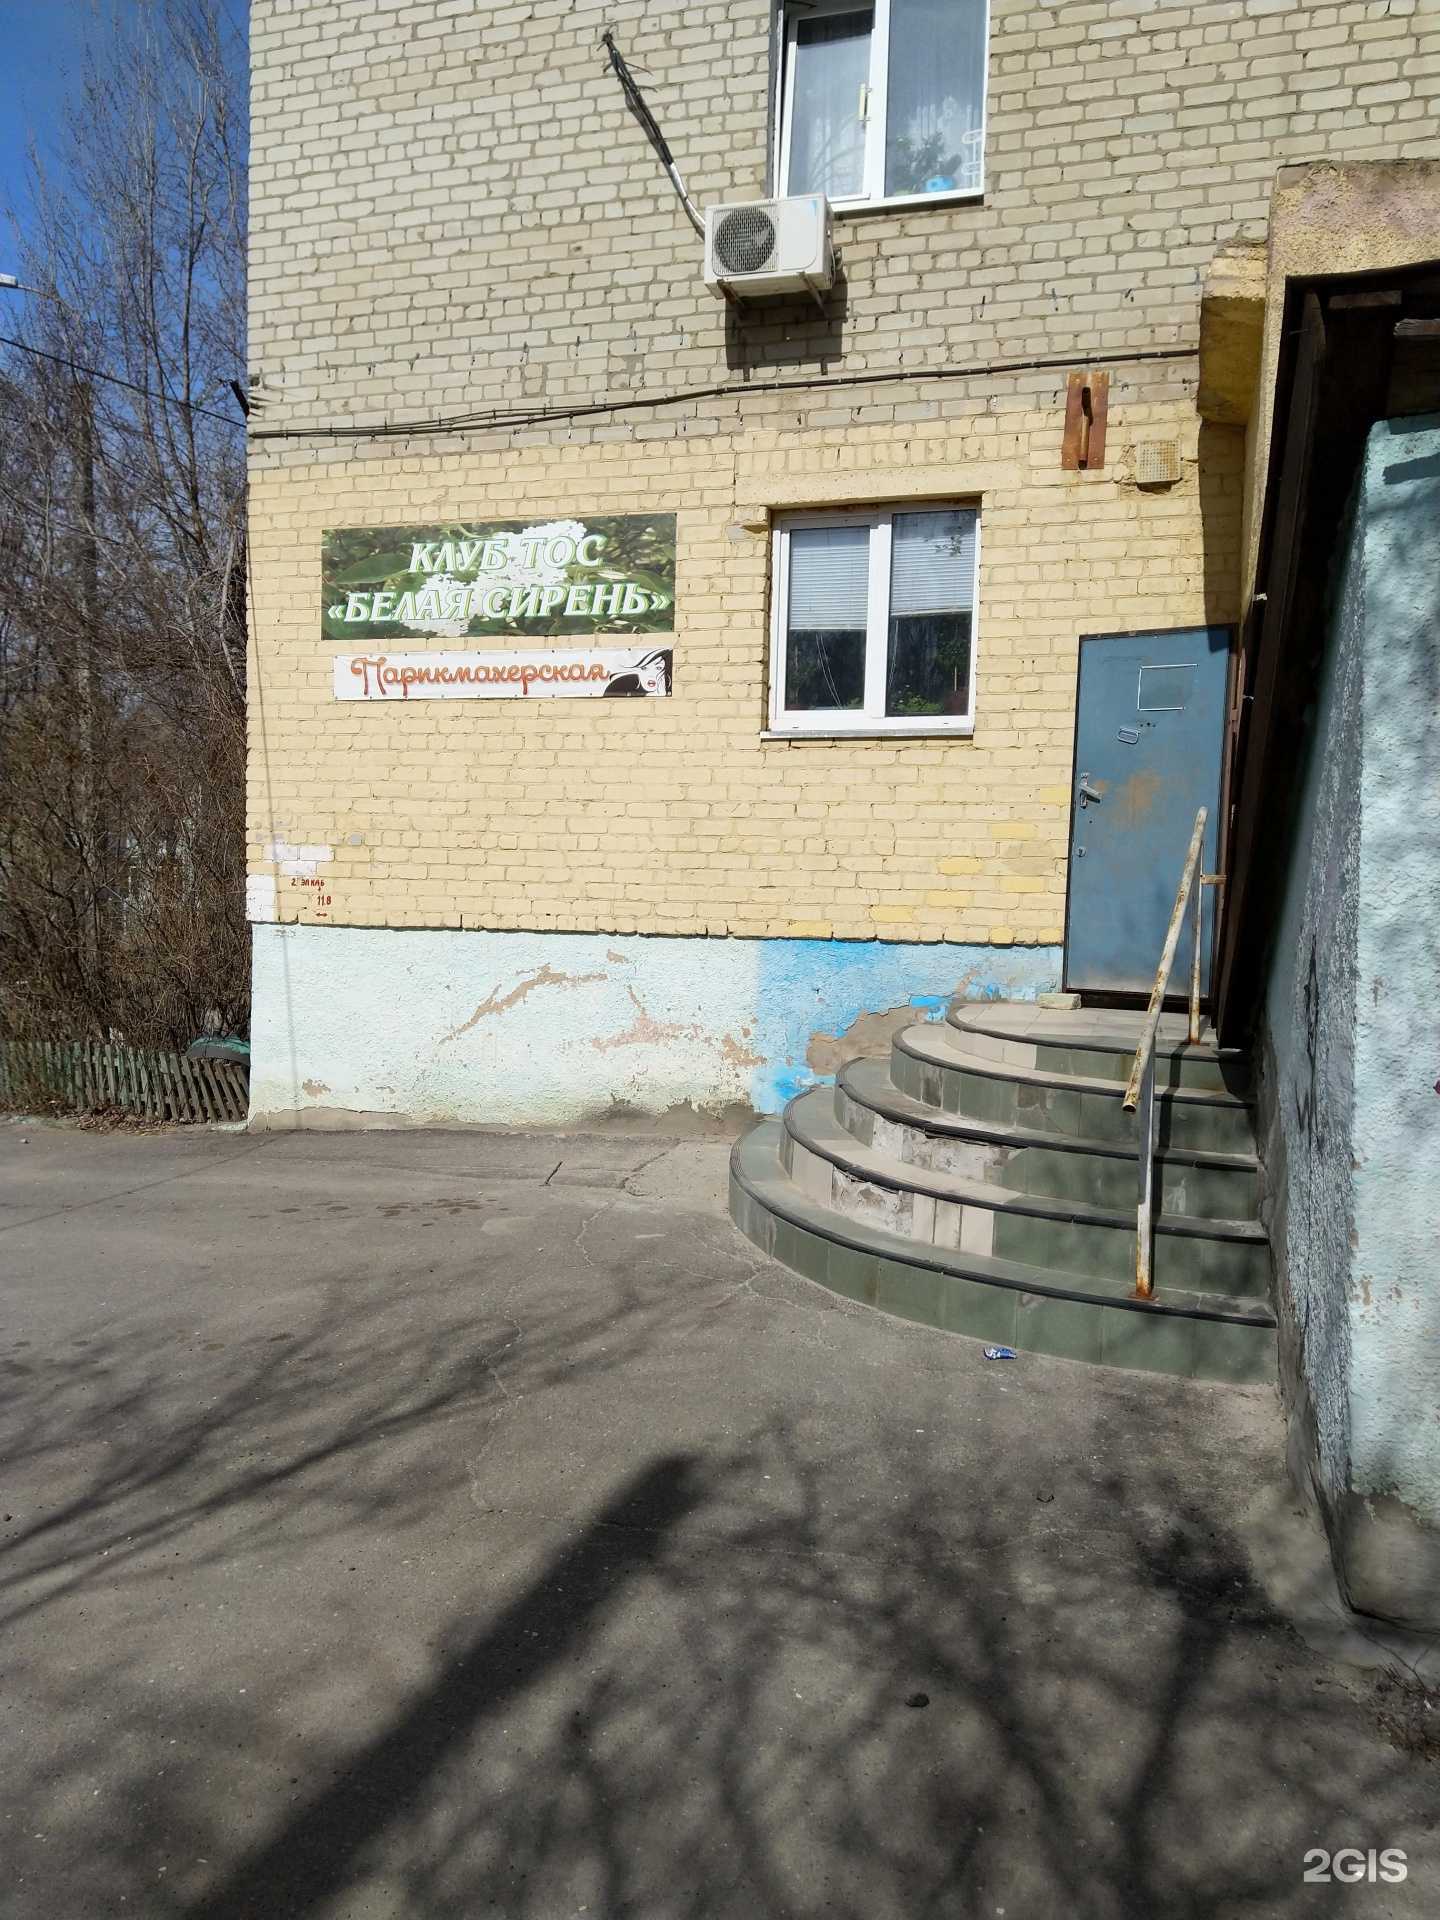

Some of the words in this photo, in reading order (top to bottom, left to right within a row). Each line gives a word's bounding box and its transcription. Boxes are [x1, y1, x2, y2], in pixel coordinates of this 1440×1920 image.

[408, 538, 509, 573] КЛУБ
[521, 534, 607, 568] ТОС
[327, 589, 474, 622] «БЕЛАЯ
[483, 582, 672, 618] СИРЕНЬ»
[350, 656, 610, 696] Парикмахерская
